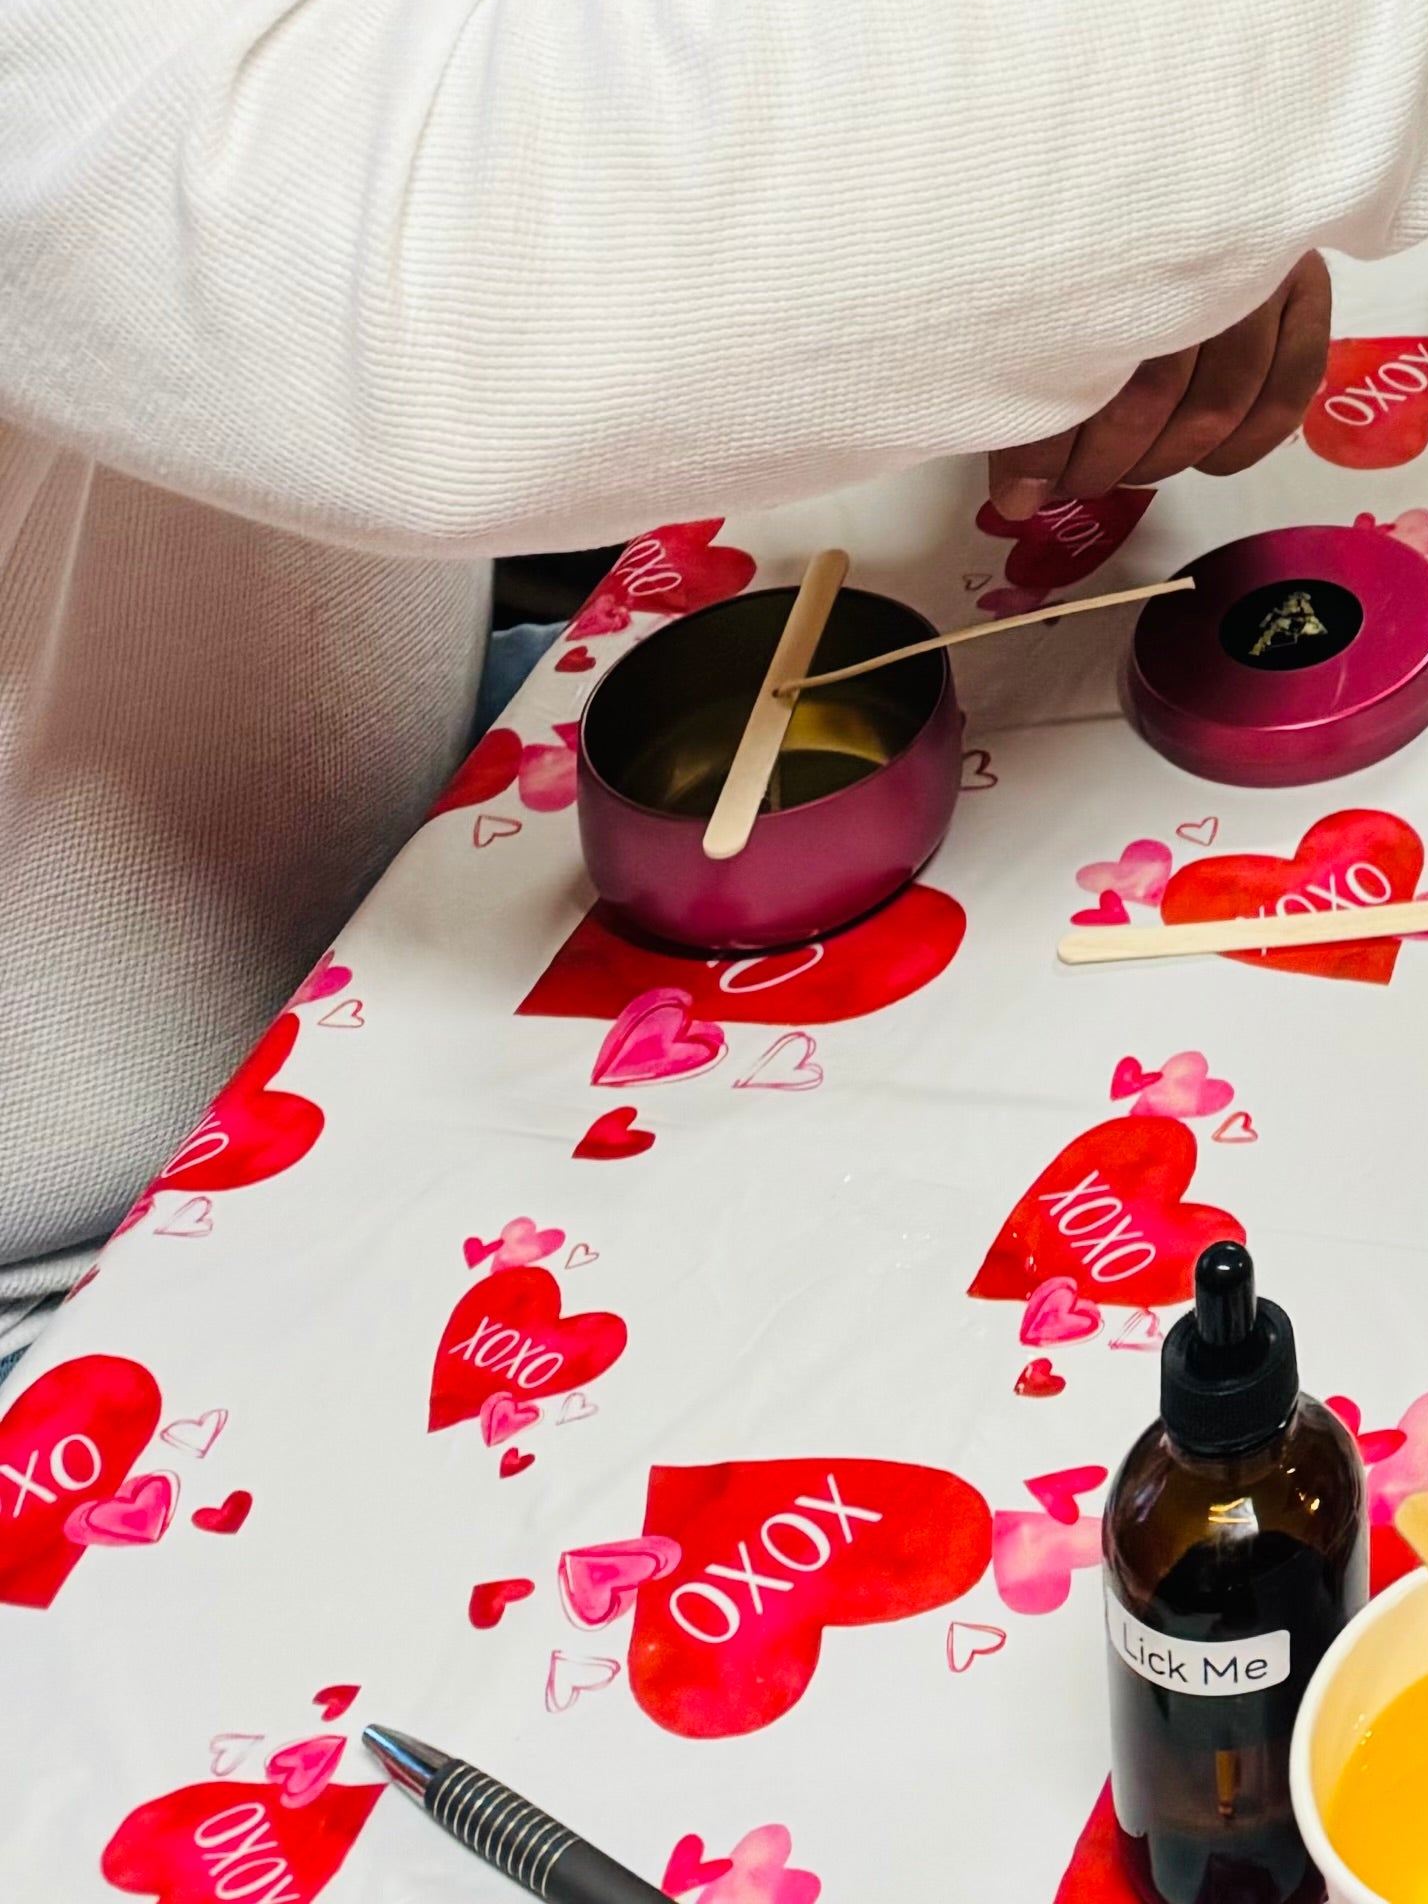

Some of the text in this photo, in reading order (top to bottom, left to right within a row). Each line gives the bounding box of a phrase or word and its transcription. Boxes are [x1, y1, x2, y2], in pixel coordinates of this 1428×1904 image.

[617, 537, 684, 597] OXO
[1039, 1170, 1156, 1284] XOXO
[449, 1316, 565, 1389] XOXO
[0, 1432, 103, 1517] XO
[1122, 1622, 1268, 1684] Lick Me
